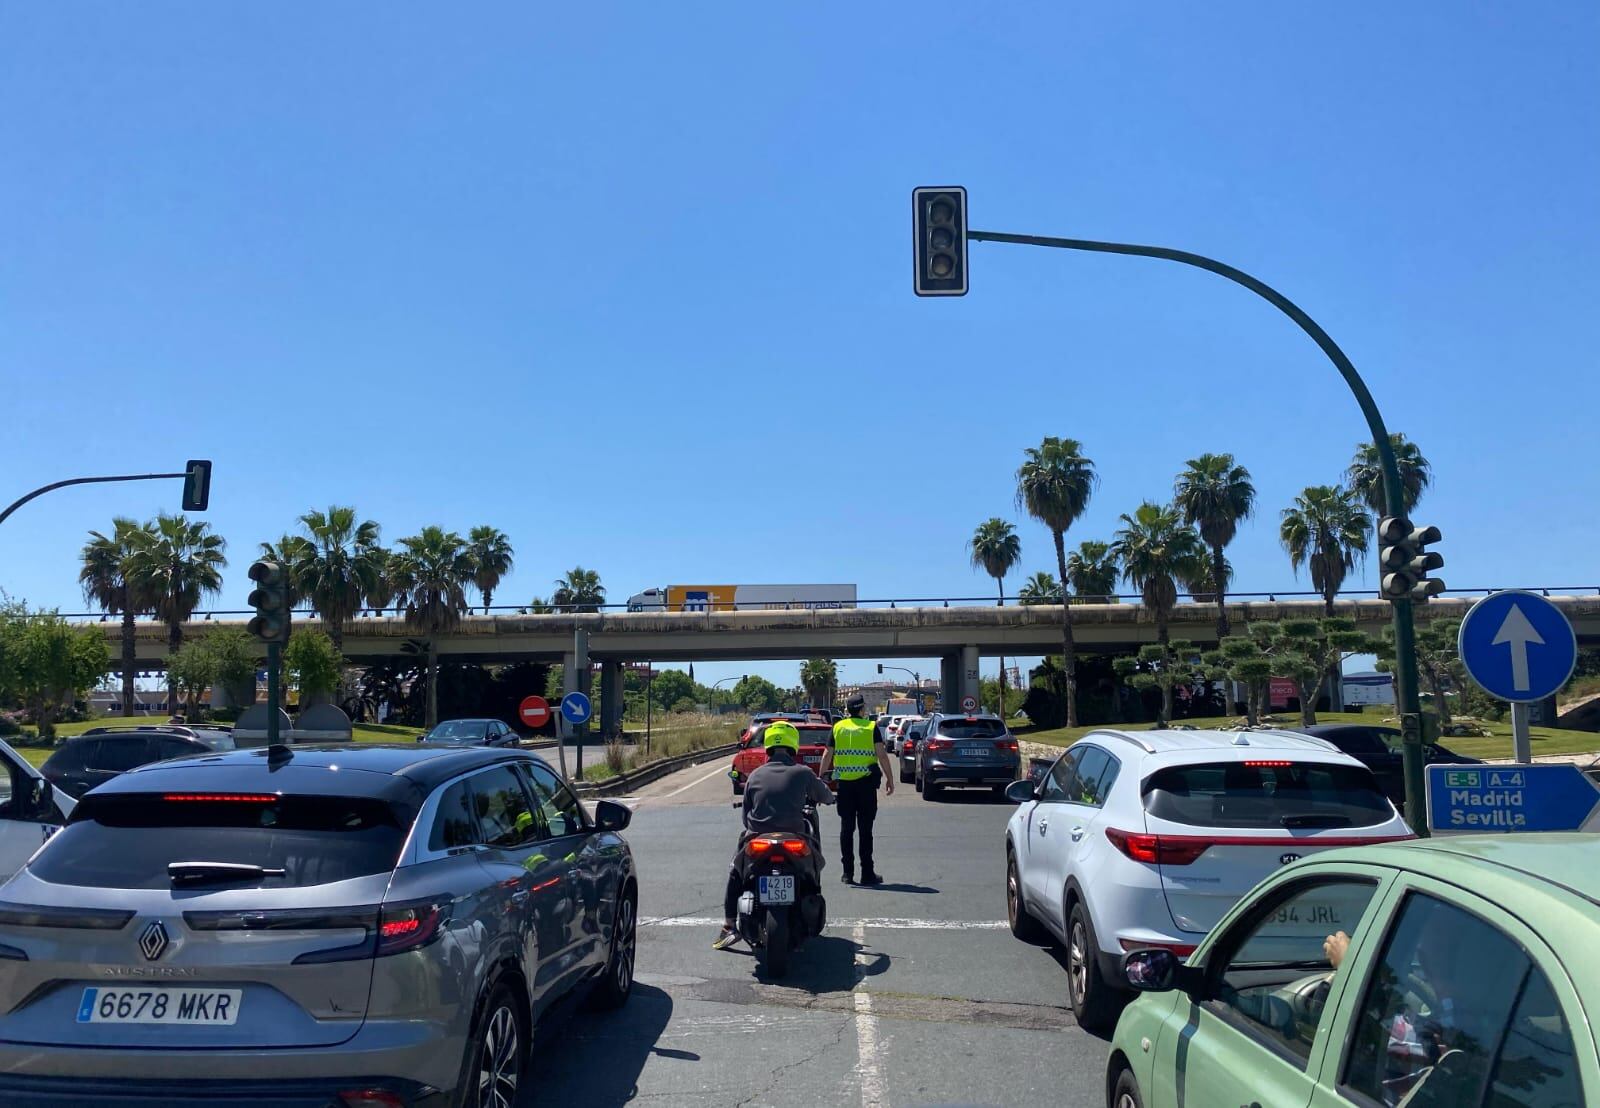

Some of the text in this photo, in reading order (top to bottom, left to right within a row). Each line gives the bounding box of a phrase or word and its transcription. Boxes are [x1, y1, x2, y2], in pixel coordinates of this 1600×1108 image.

[1448, 772, 1523, 786] E-5 A-4
[1451, 790, 1523, 807] Madrid
[1451, 809, 1526, 827] Sevilla
[768, 877, 793, 889] 4219
[768, 889, 787, 901] LSG
[1306, 906, 1341, 923] JRL
[104, 966, 200, 977] AUSTRAL
[99, 991, 169, 1019] 6678
[177, 993, 232, 1021] MKR
